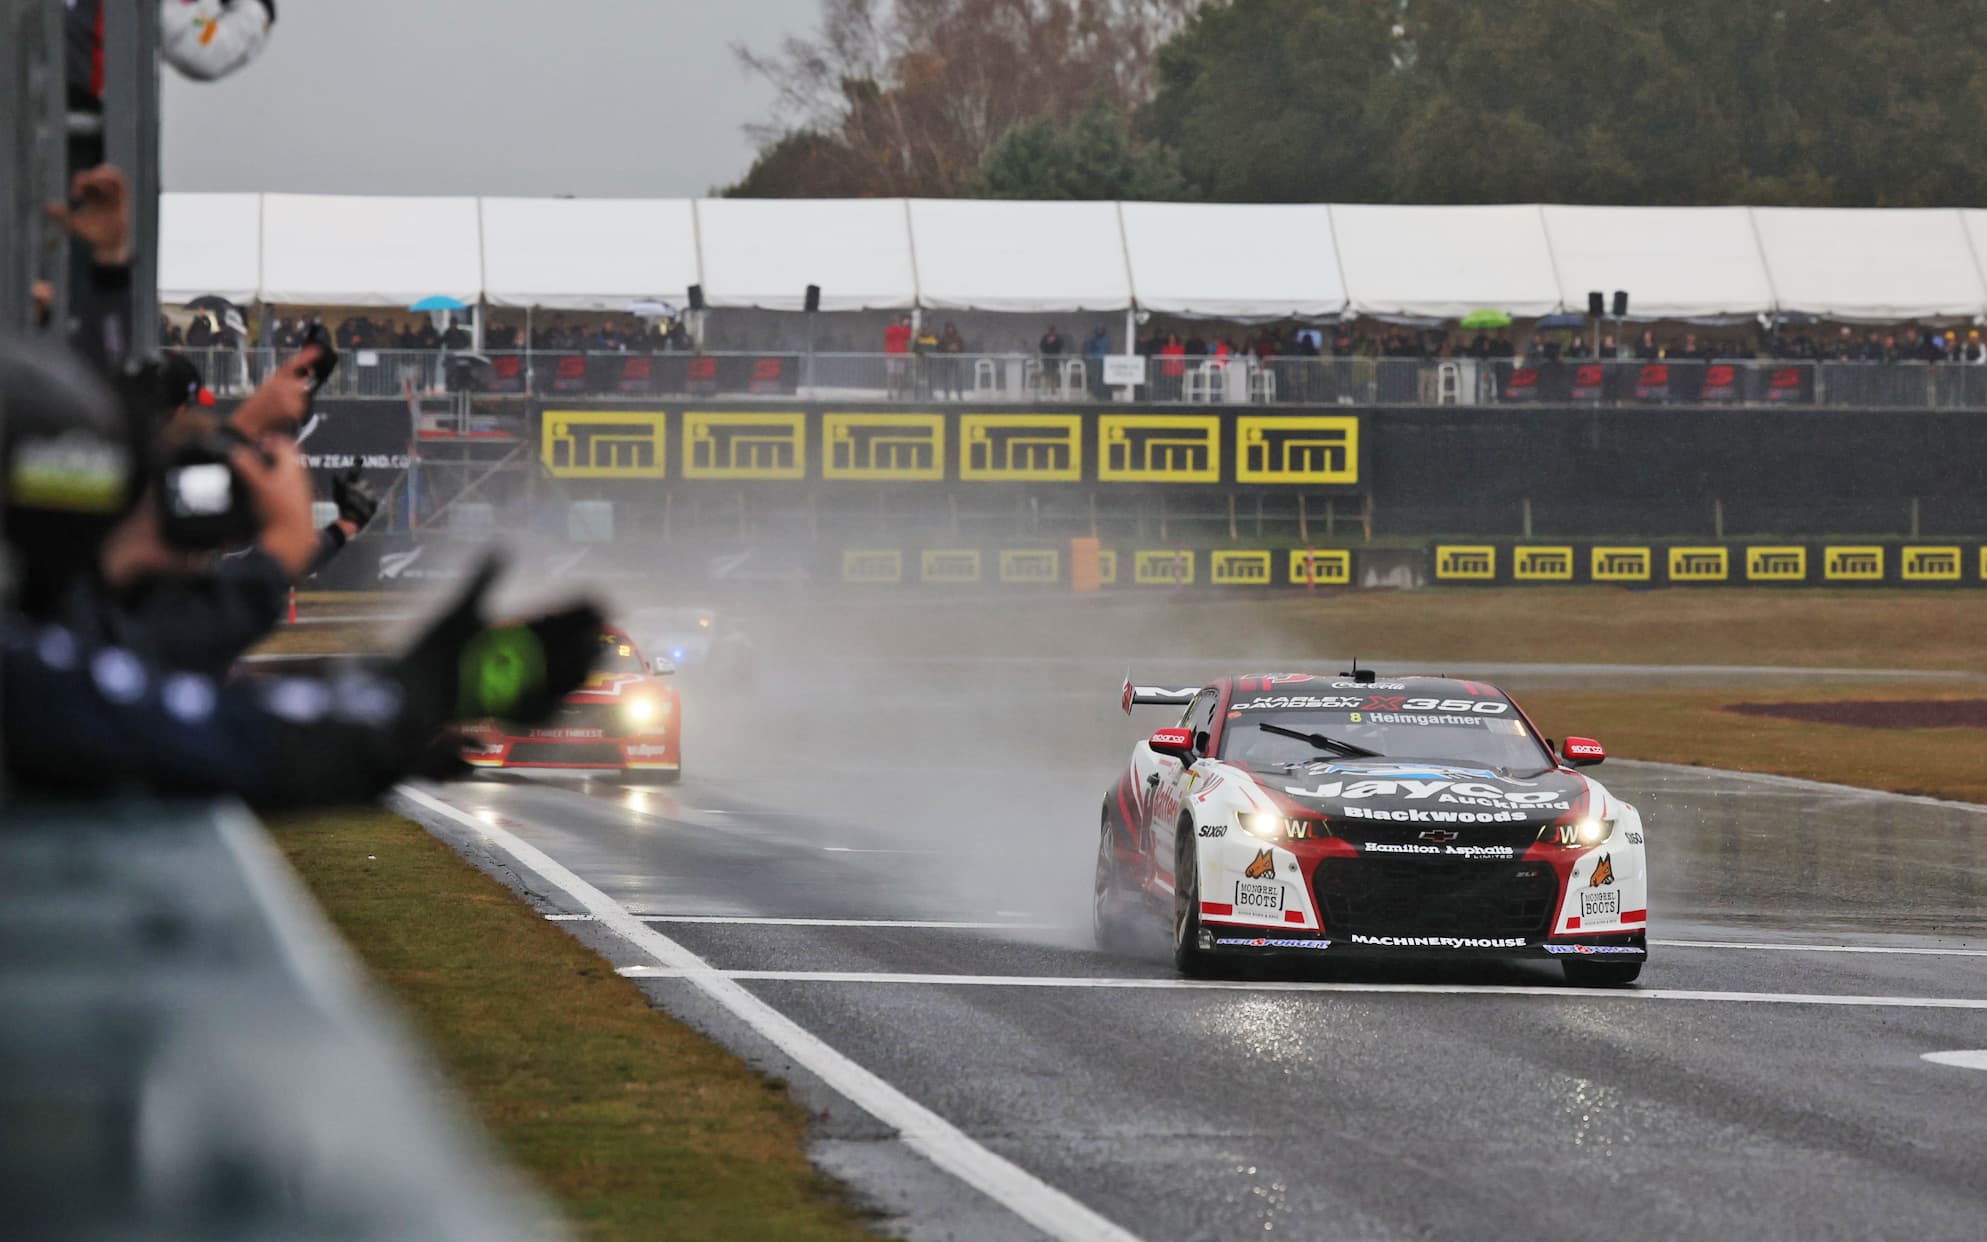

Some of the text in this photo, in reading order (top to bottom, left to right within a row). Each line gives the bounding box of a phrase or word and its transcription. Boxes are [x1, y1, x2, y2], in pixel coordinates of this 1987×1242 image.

[1231, 701, 1361, 711] DAVIDSON
[1350, 712, 1481, 725] 8 Heimgartner
[1438, 793, 1570, 809] Auckland
[1343, 806, 1527, 822] Blackwoods
[1198, 825, 1228, 838] SIX60
[1364, 842, 1514, 858] Hamilton Asphalts
[1240, 882, 1279, 896] MONGREL
[1240, 892, 1278, 908] BOOTS
[1585, 901, 1616, 914] BOOTS
